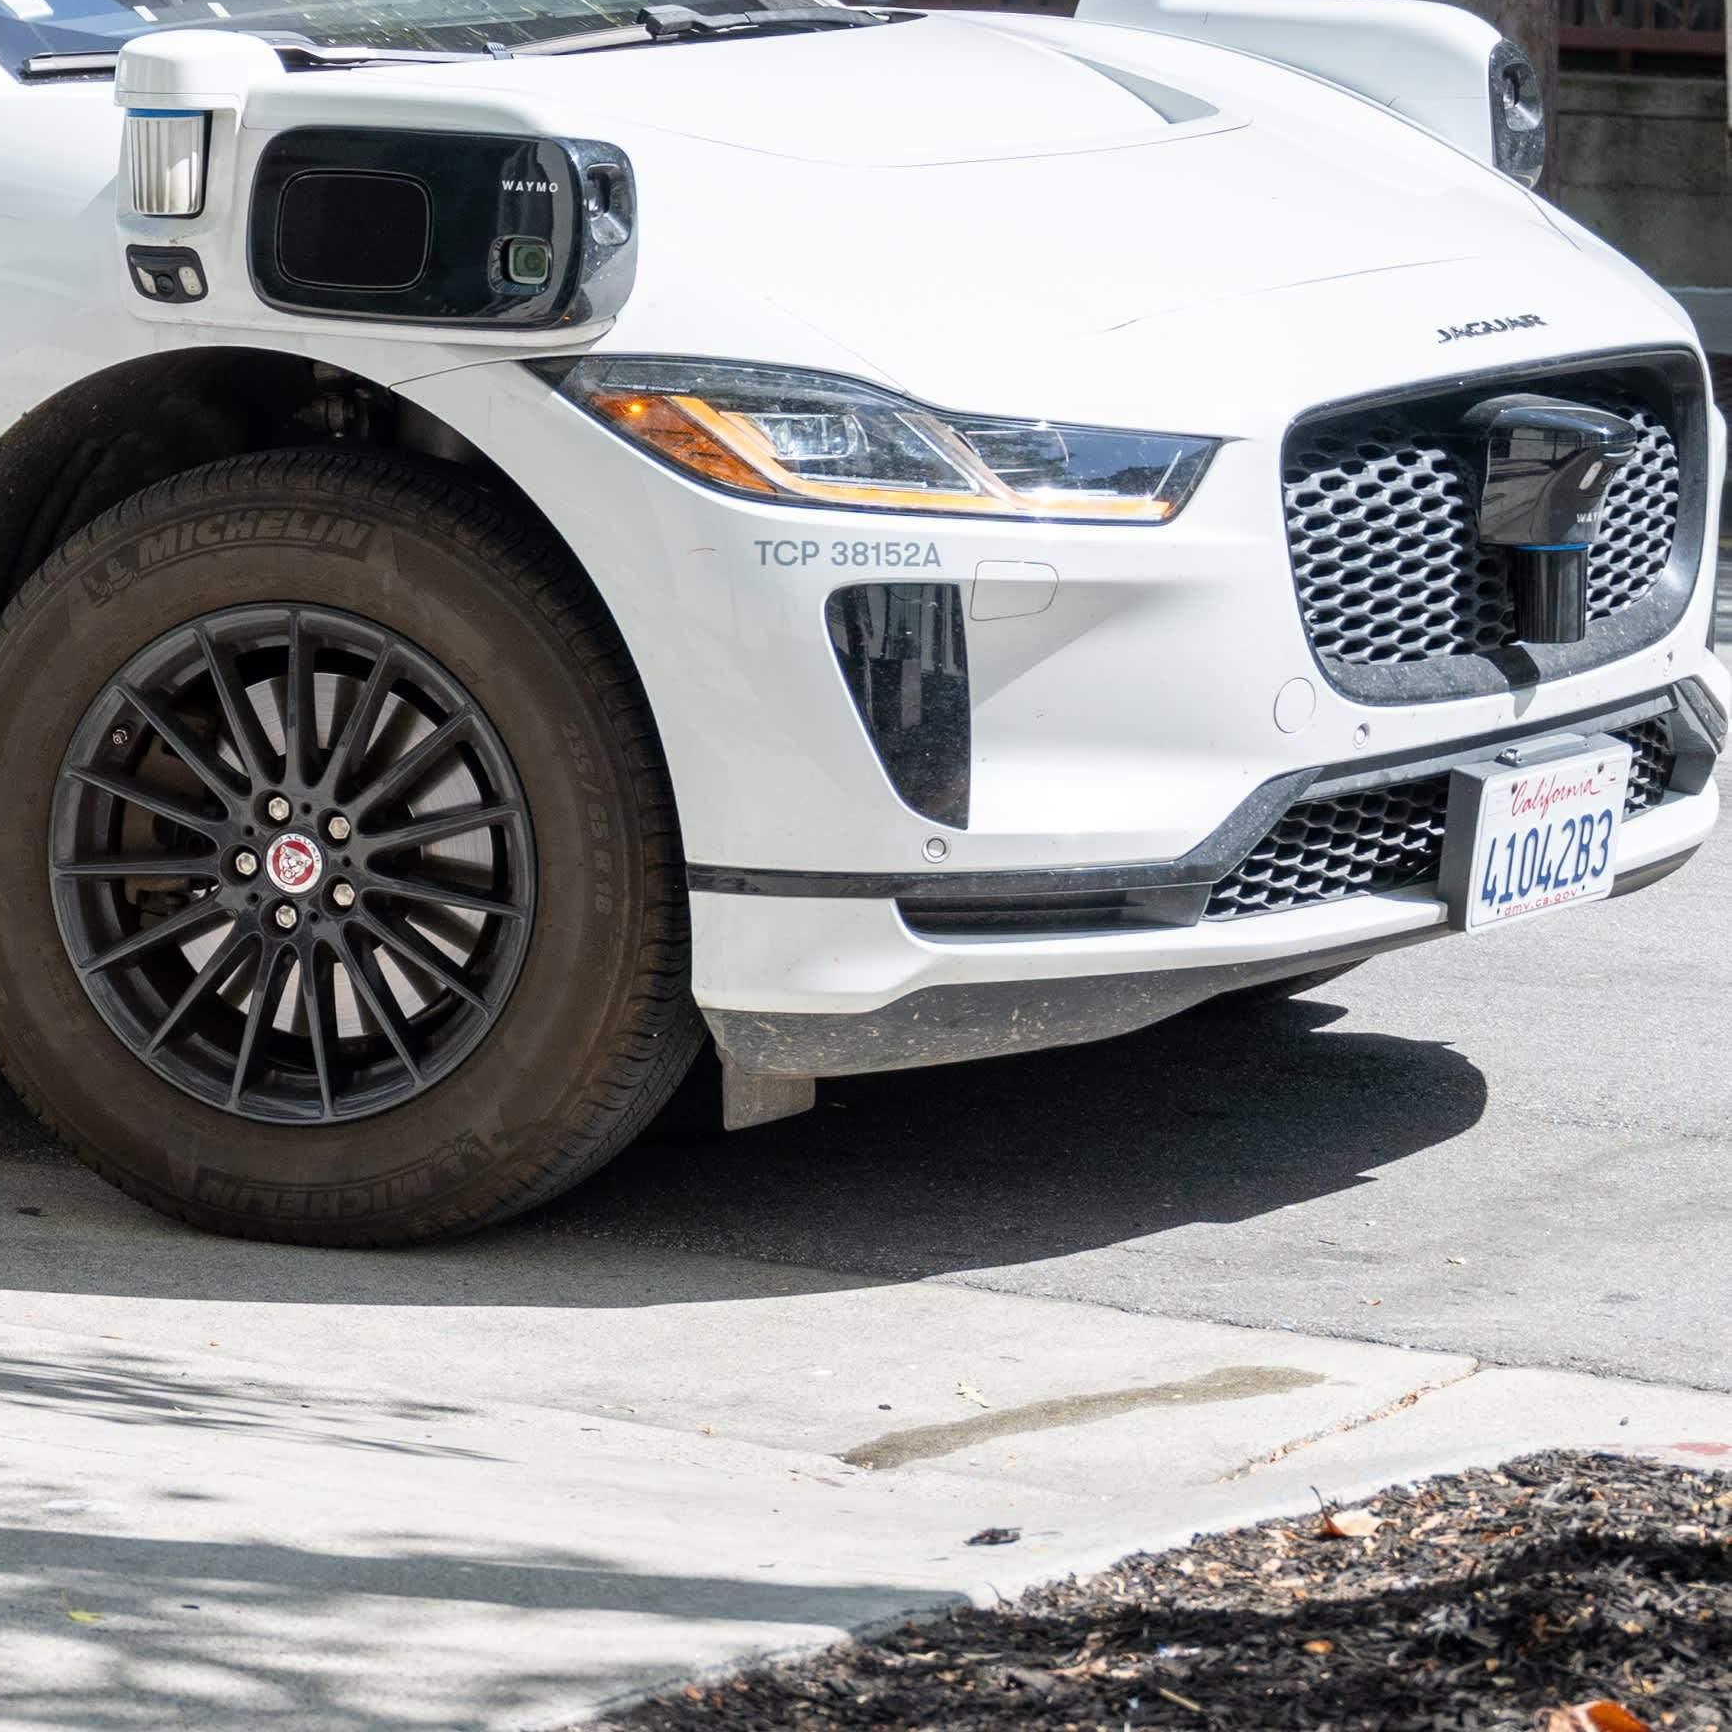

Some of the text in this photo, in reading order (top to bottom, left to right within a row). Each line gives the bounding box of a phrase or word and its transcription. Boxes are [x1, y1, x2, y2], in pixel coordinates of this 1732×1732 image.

[501, 179, 559, 194] WAYMO
[1436, 313, 1548, 344] JAGUAR
[137, 509, 374, 570] MICHELIN
[754, 540, 942, 567] TCP 38152A
[1511, 773, 1601, 820] California
[1480, 808, 1614, 908] 41042B3
[1503, 887, 1579, 918] dmv.ca.gov
